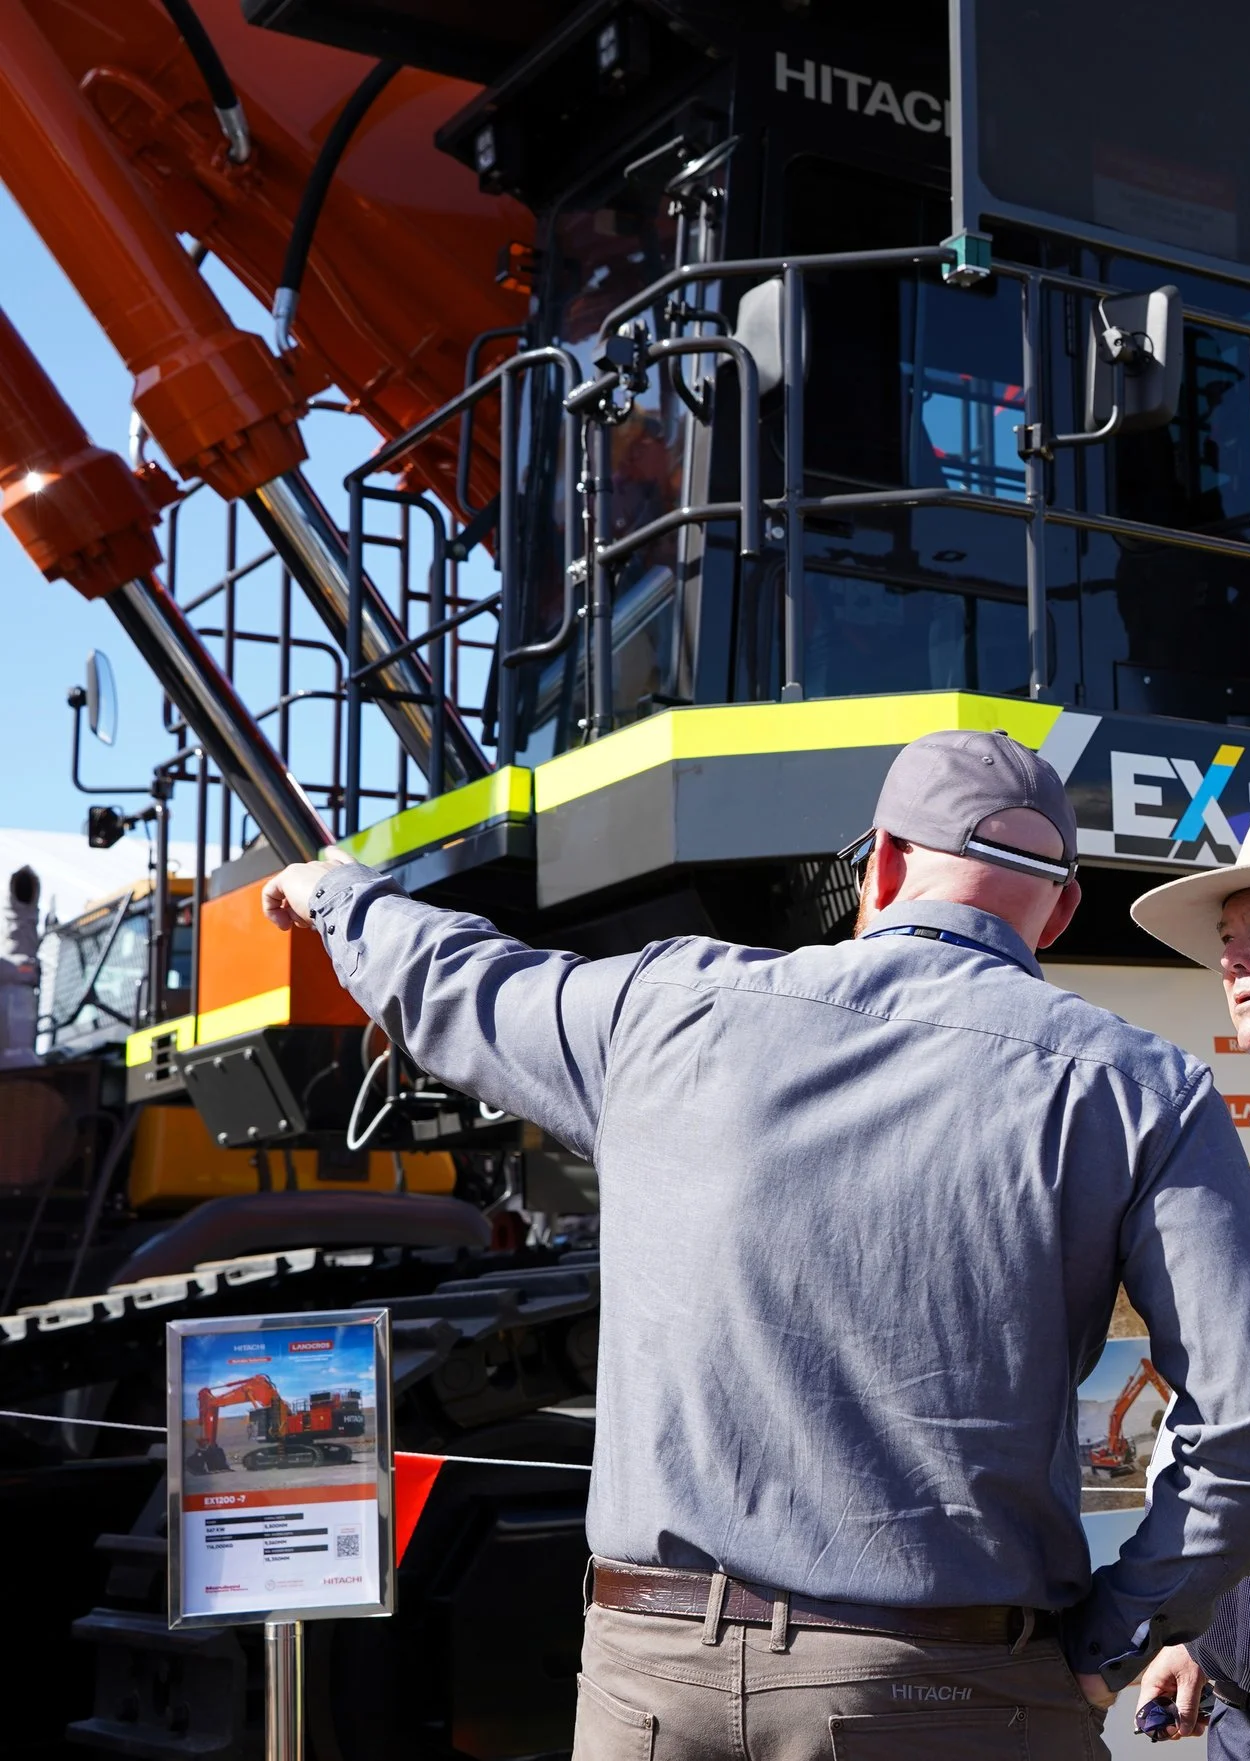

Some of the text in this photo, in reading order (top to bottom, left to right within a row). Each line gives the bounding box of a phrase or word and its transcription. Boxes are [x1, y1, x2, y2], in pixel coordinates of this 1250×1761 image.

[775, 51, 951, 138] HITAC
[233, 1343, 266, 1351] HITACHI
[204, 1496, 236, 1505] EX1200
[323, 1576, 362, 1585] HITACHI
[891, 1683, 972, 1701] HITACHI
